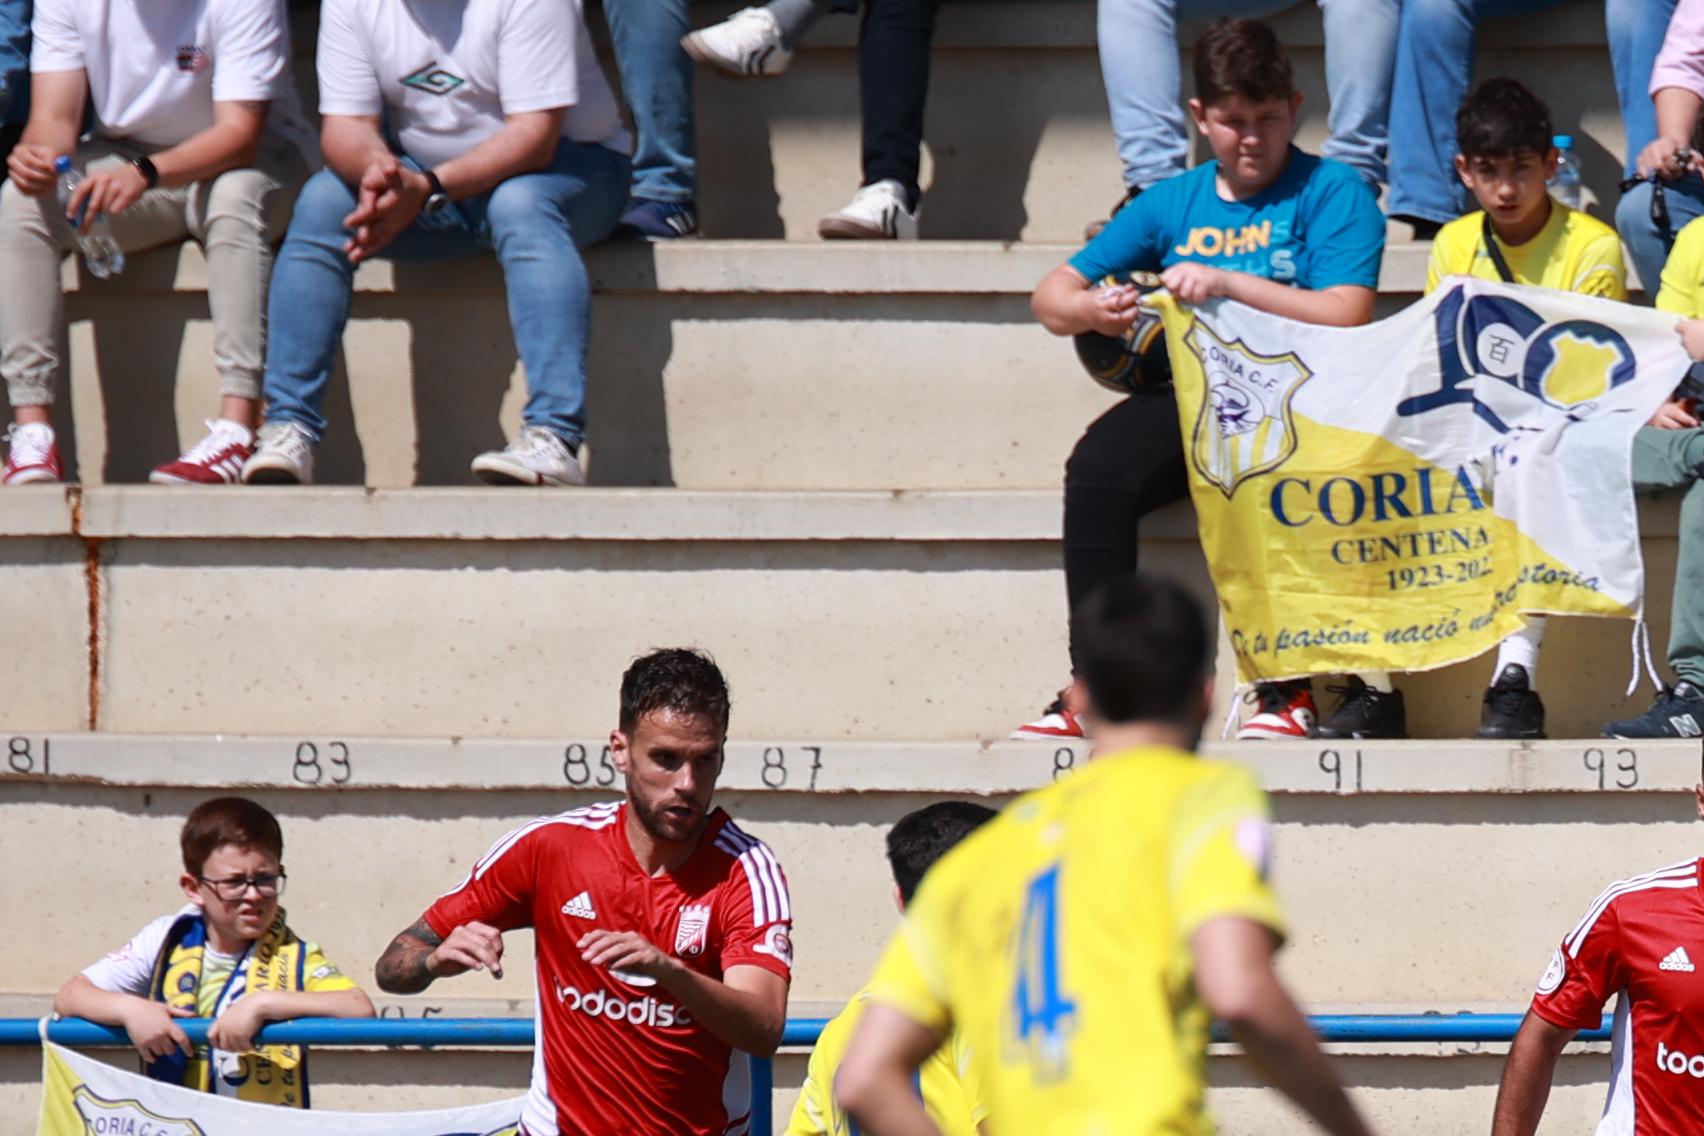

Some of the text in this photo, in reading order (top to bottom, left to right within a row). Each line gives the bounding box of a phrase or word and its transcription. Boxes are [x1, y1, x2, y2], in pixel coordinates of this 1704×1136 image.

[1270, 464, 1487, 527] CORIA
[1274, 620, 1370, 659] pasión
[1384, 608, 1460, 646] nació
[8, 736, 50, 775] 81
[293, 741, 352, 786] 83
[563, 744, 616, 787] 85
[761, 747, 823, 790] 87
[1319, 749, 1362, 791] 91
[1583, 747, 1638, 789] 93
[561, 904, 597, 920] adidas
[1008, 860, 1080, 1062] 4
[1659, 961, 1695, 972] adidas
[87, 1117, 135, 1136] ORIA
